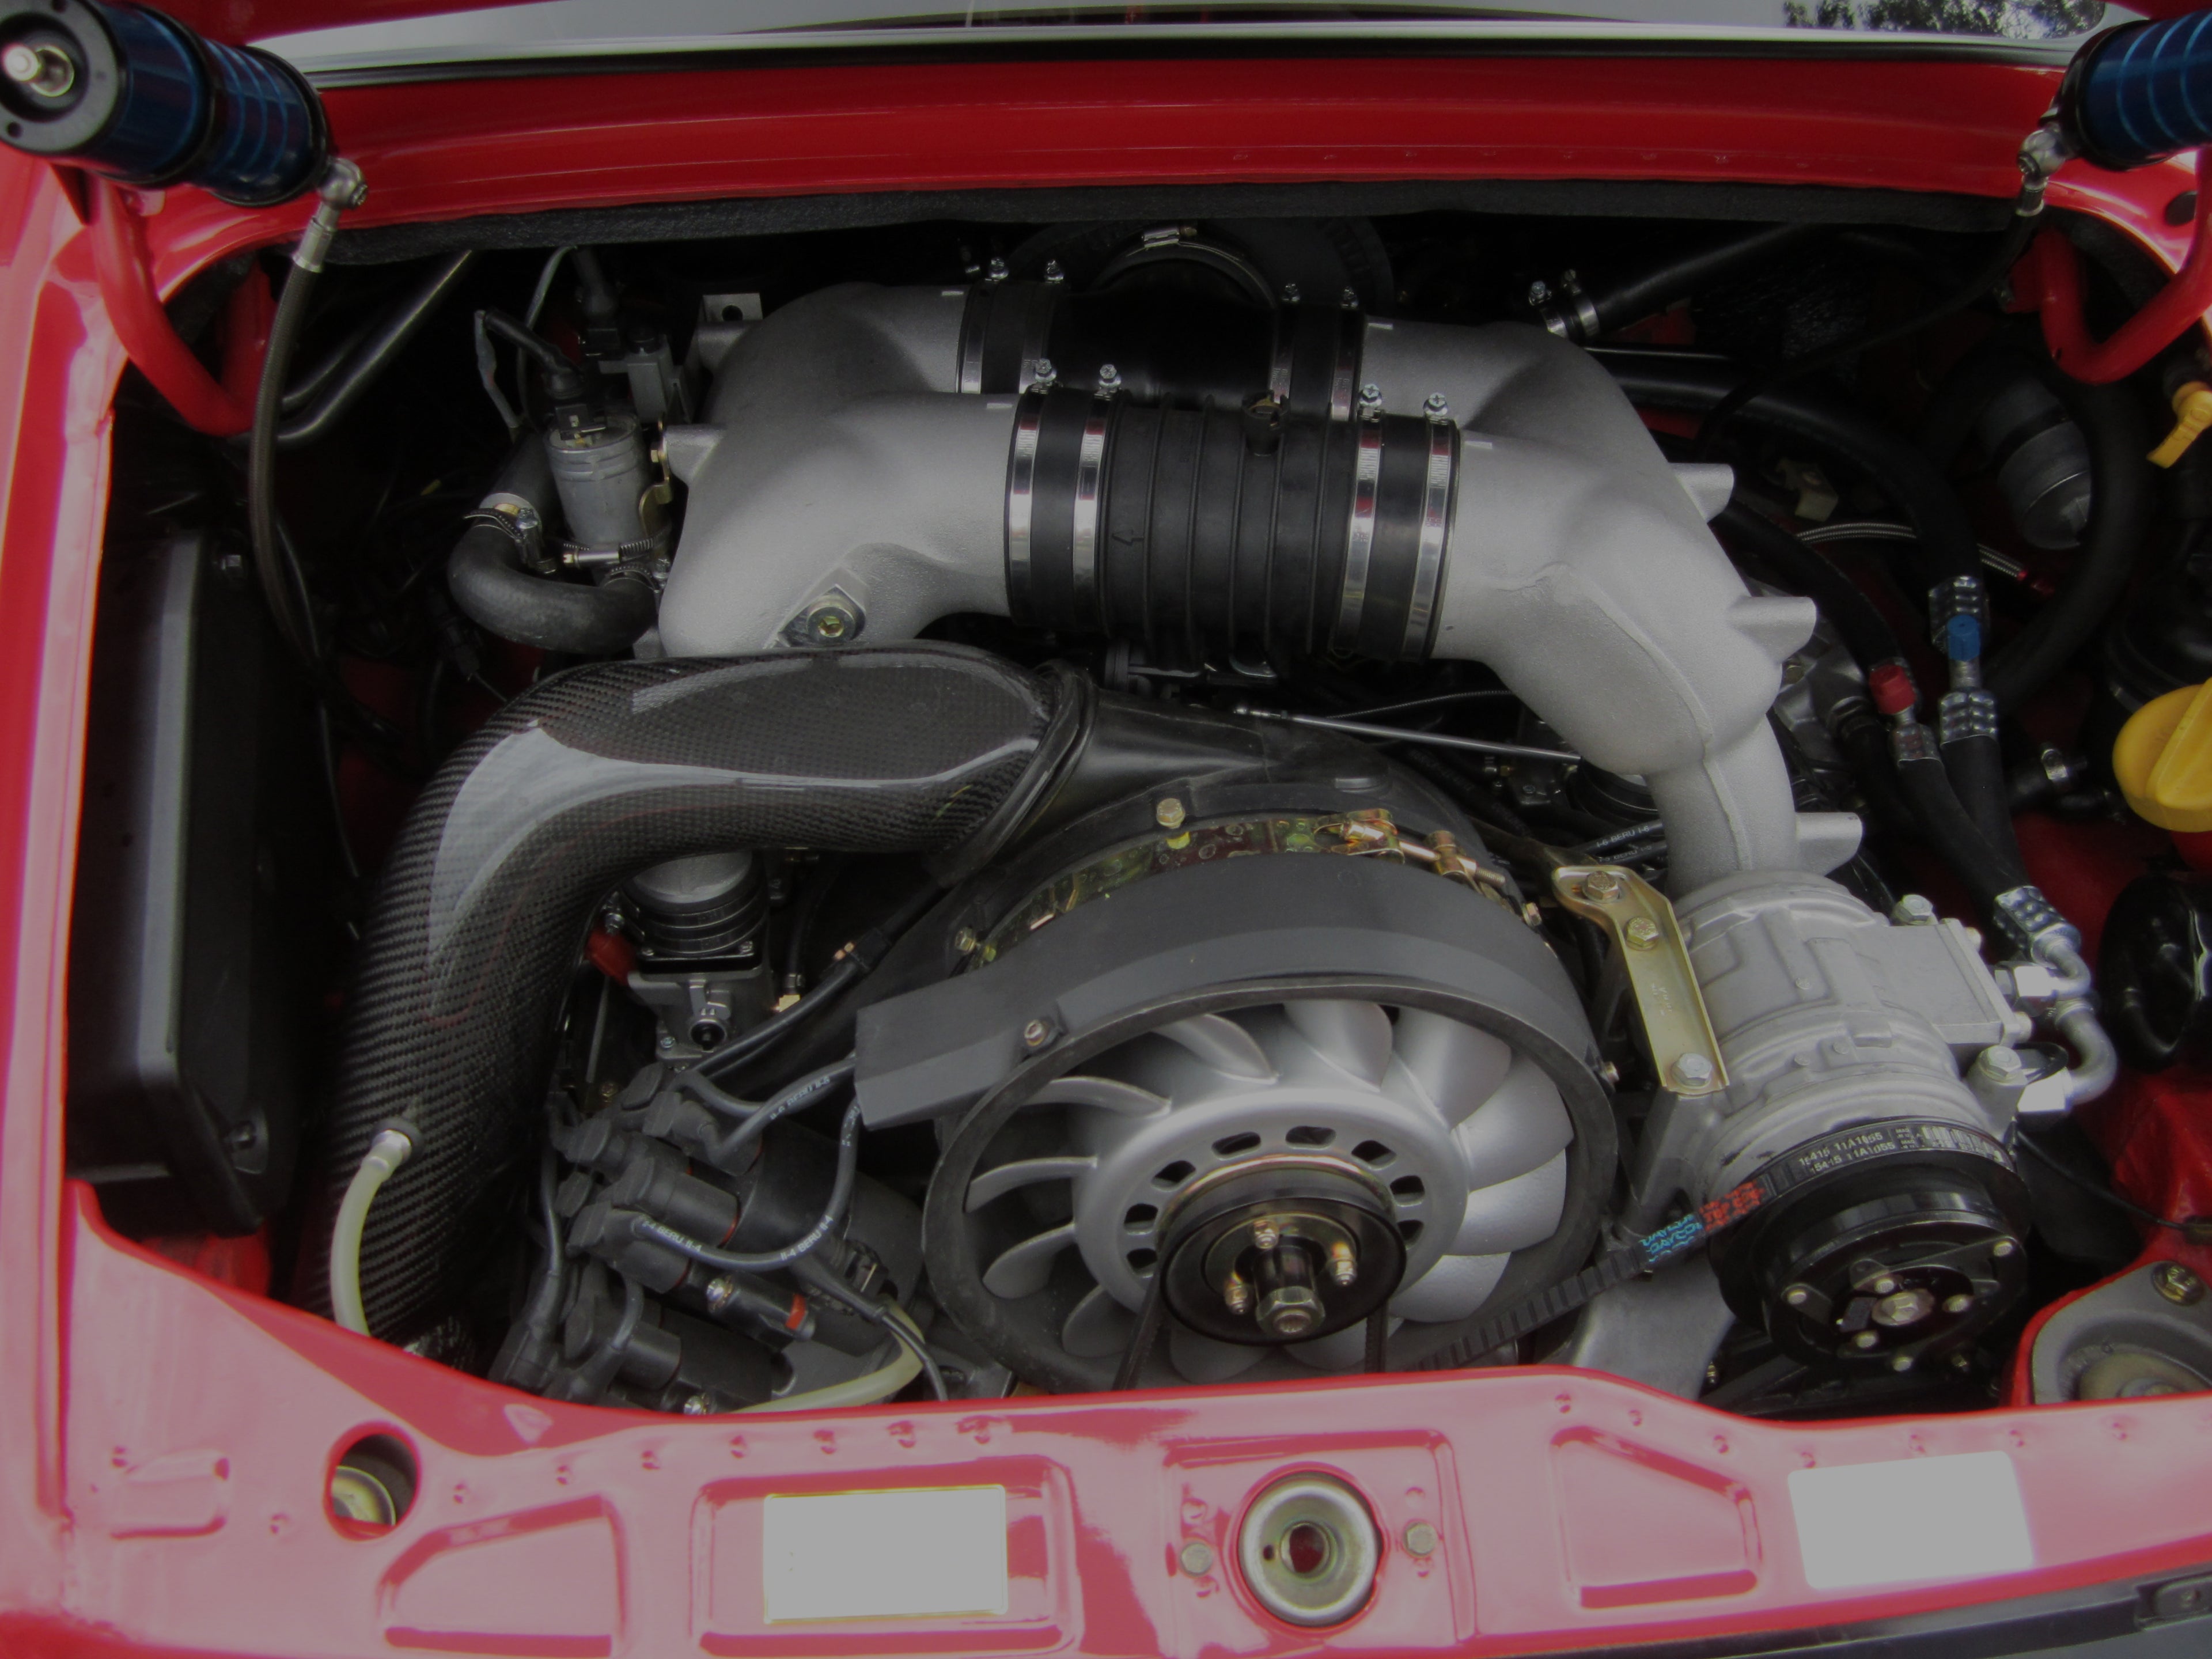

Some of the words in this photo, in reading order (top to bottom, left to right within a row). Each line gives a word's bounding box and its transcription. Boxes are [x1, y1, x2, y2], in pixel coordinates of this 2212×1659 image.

[1611, 830, 1635, 843] BERU
[1809, 1154, 1843, 1175] 15415
[1846, 1141, 1896, 1161] 11A1055
[657, 1226, 685, 1244] BERU
[797, 1229, 823, 1252] BERU
